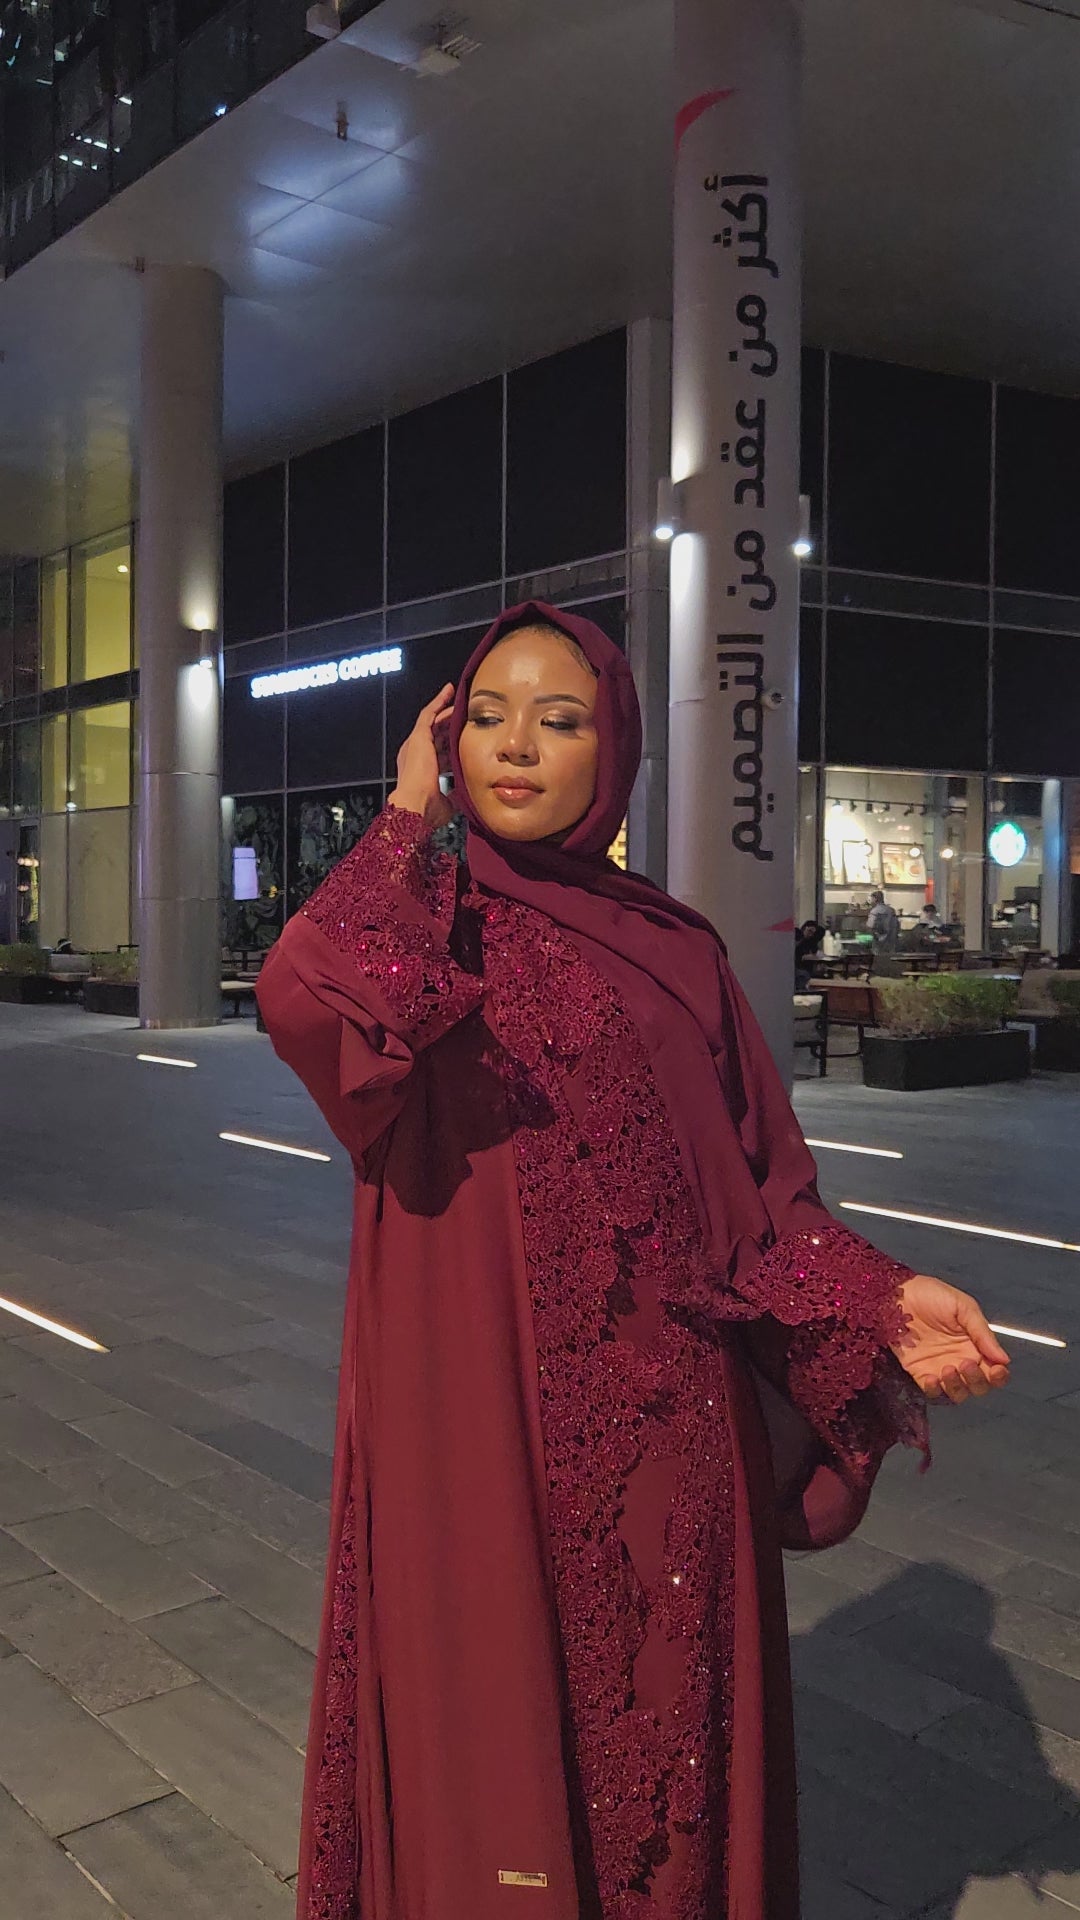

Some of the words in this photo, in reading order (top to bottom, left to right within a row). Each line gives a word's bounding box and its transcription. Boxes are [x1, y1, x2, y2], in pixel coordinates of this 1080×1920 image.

[704, 174, 779, 277] أكثر
[729, 293, 778, 378] من
[720, 399, 767, 508] عقد
[727, 529, 777, 611] من
[338, 647, 403, 681] COFFEE
[717, 633, 775, 862] التصميم
